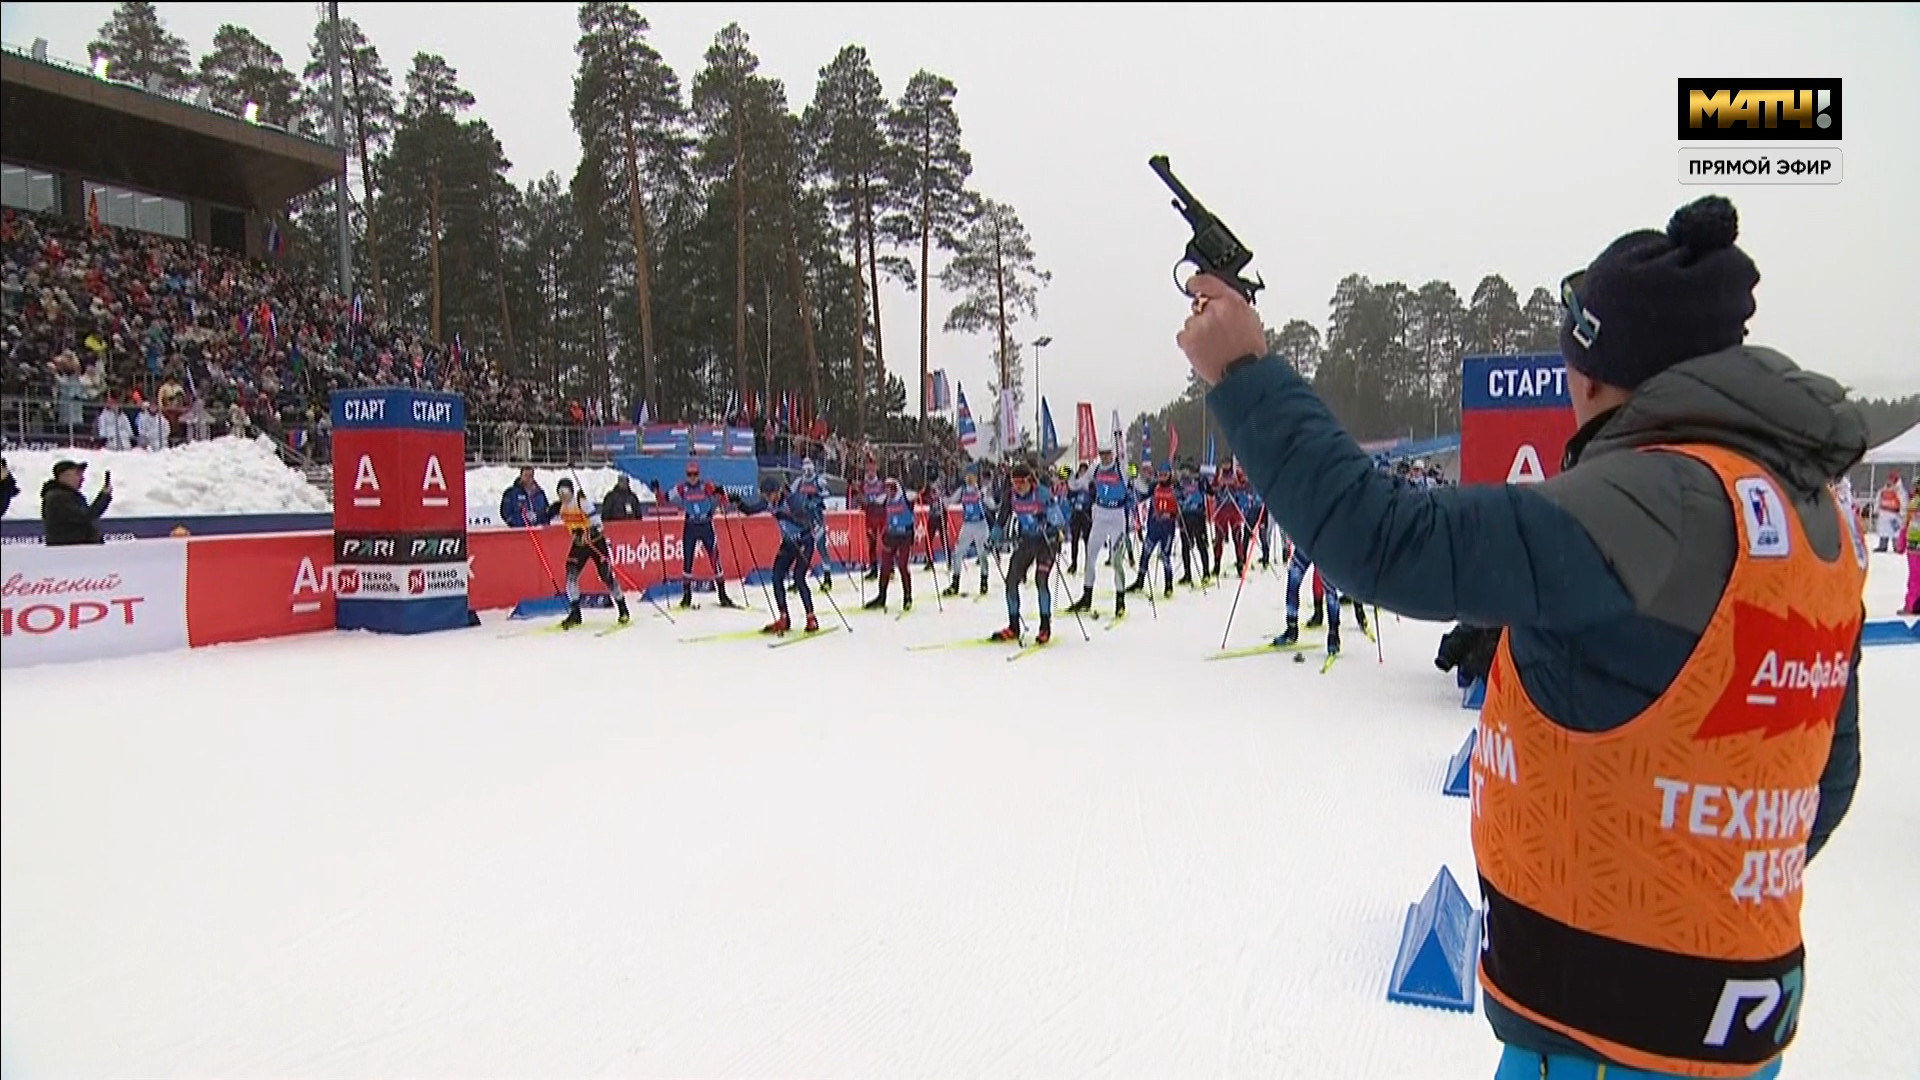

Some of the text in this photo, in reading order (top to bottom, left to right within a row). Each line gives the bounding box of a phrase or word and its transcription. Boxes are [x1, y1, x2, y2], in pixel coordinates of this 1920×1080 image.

[1489, 367, 1567, 397] СТАРТ
[344, 398, 386, 421] СТАРТ
[412, 400, 452, 423] СТАРТ
[342, 539, 396, 558] PARI
[411, 537, 461, 557] PARI
[361, 571, 393, 582] ТЕХНО
[426, 569, 458, 580] ТЕХНО
